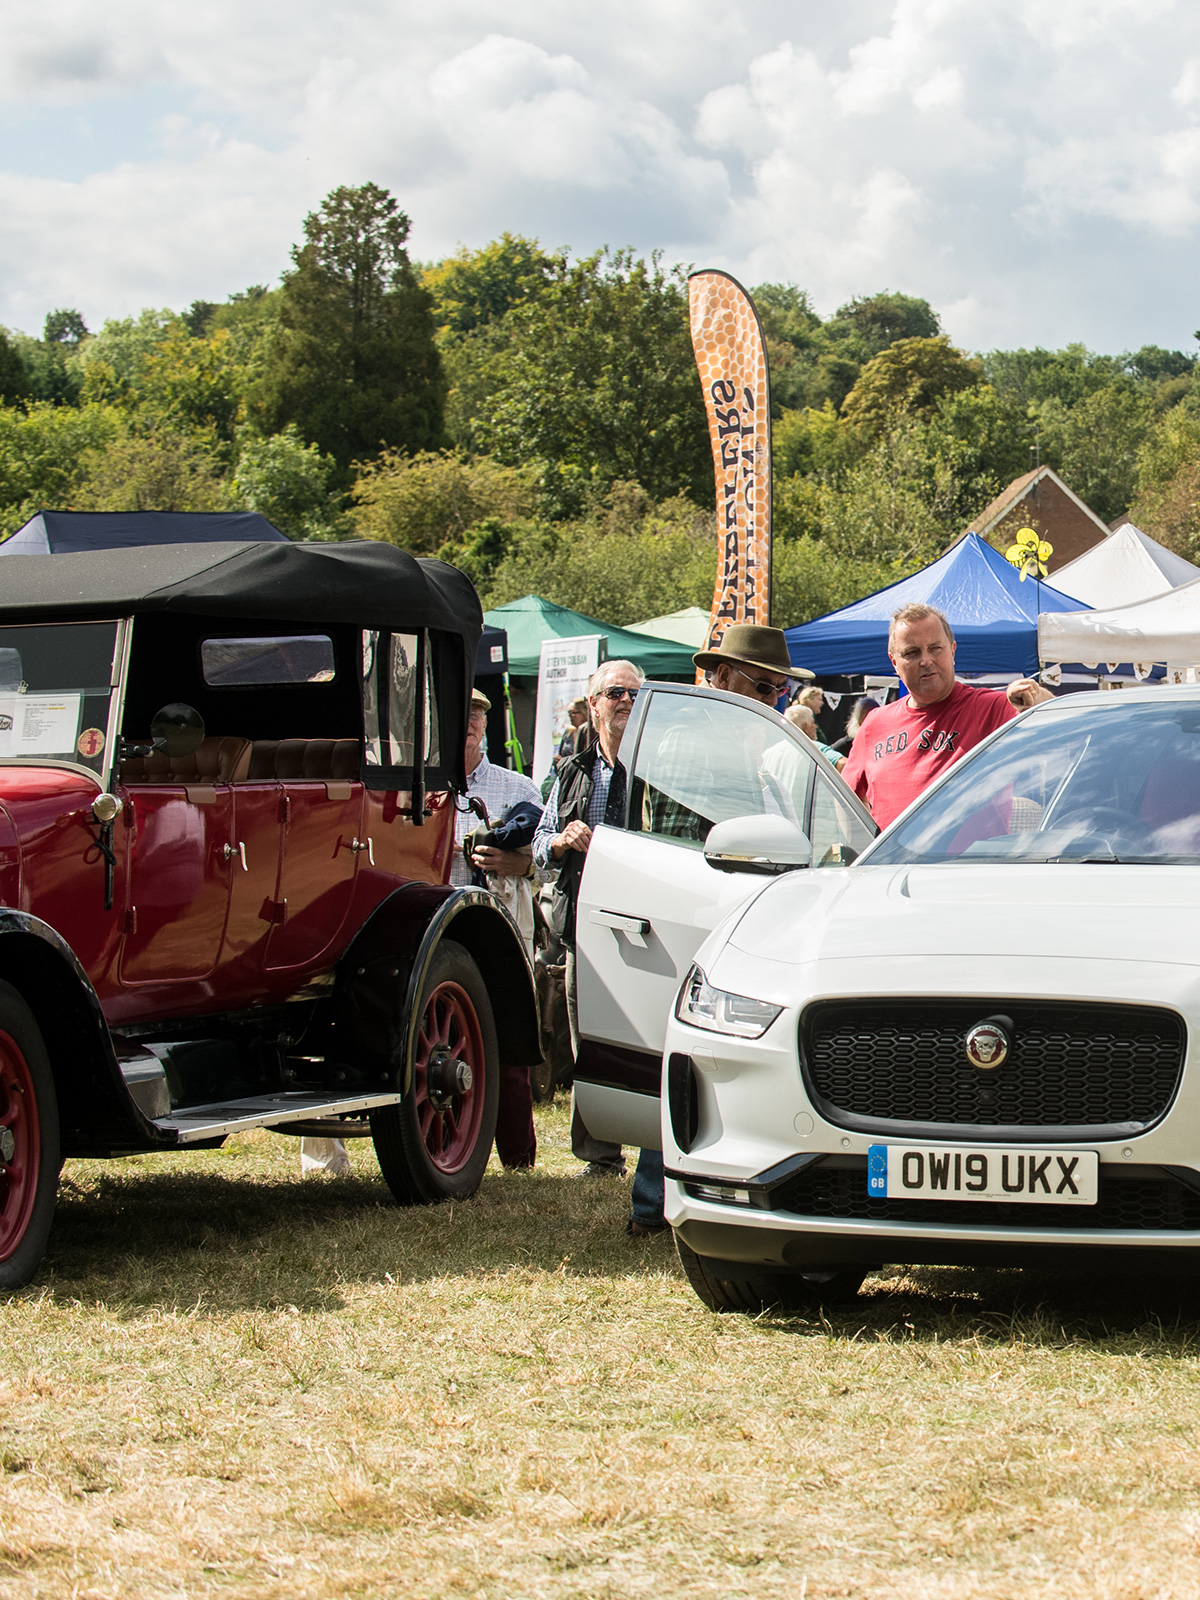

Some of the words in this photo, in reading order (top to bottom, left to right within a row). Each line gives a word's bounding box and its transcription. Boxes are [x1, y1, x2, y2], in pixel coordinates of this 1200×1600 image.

[546, 667, 568, 679] AUTHOR
[874, 731, 909, 762] RED
[870, 1177, 885, 1189] GB
[902, 1152, 988, 1192] OW19
[1001, 1154, 1080, 1195] UKX
